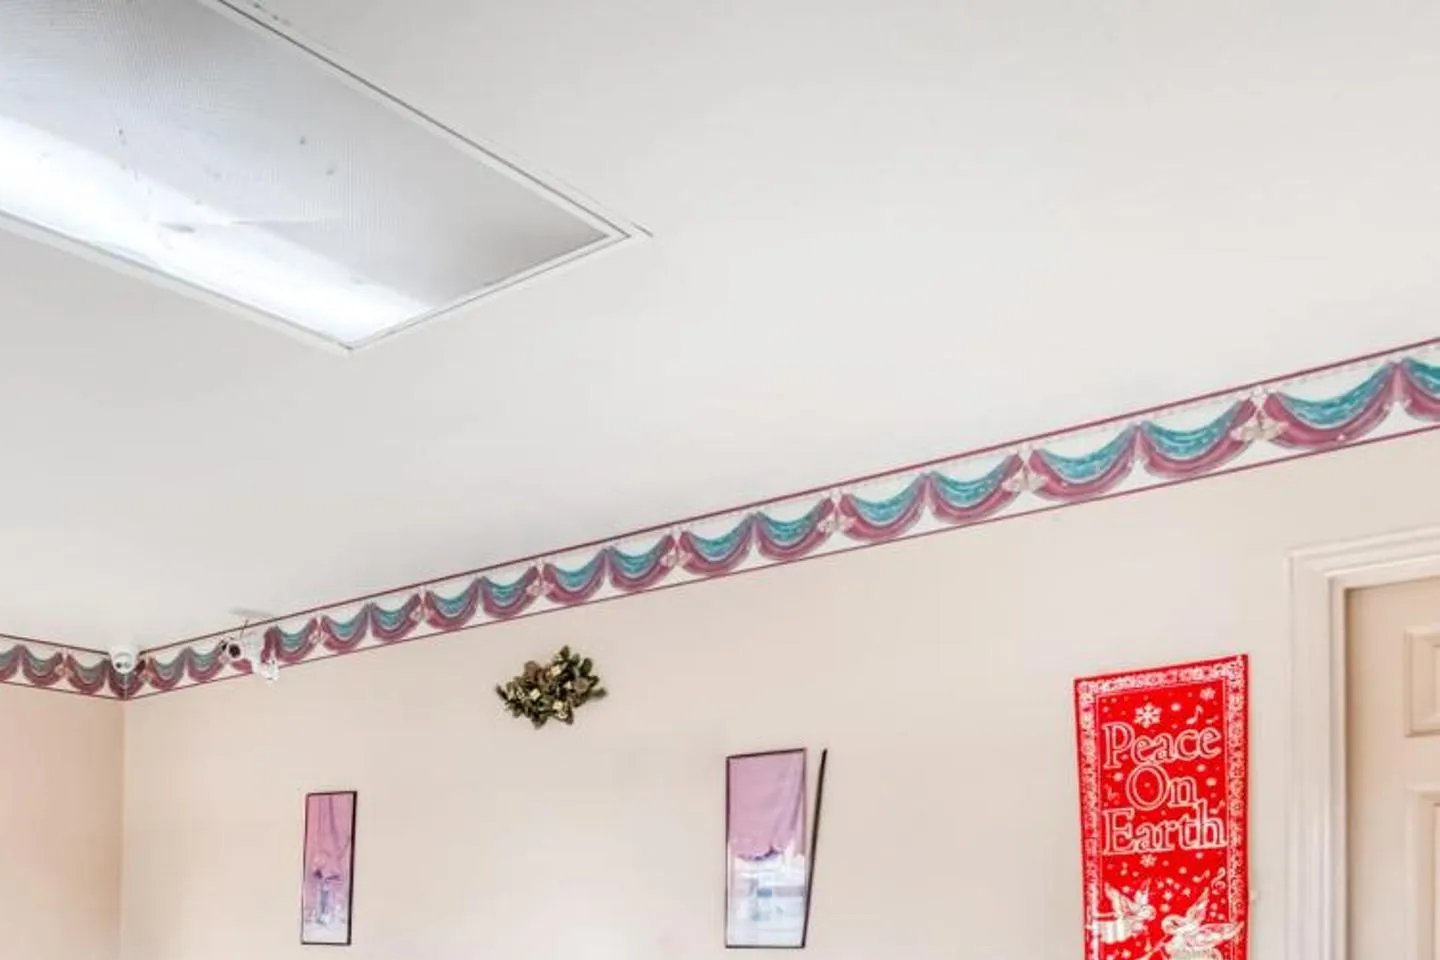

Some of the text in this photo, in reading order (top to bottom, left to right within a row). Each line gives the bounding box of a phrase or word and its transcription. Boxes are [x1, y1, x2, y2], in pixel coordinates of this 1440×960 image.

[1102, 721, 1222, 769] Peace
[1125, 762, 1199, 811] On
[1102, 799, 1228, 855] Earth
